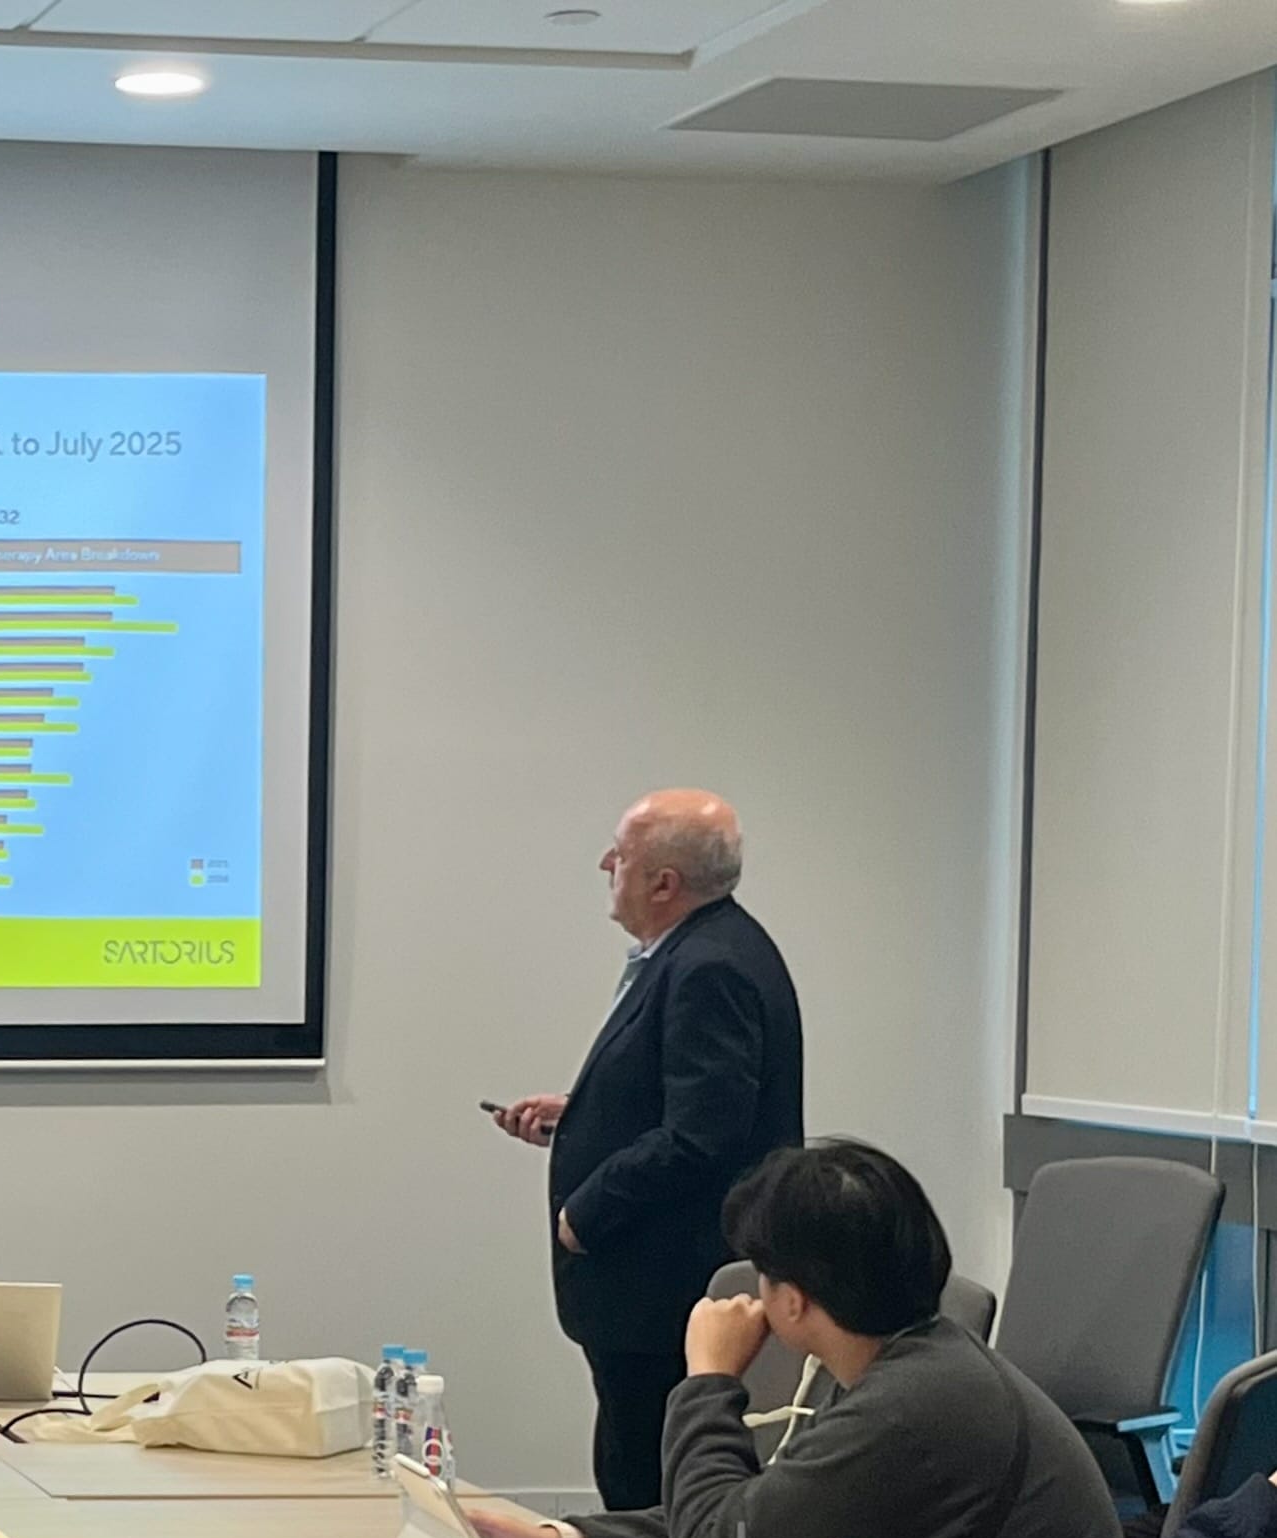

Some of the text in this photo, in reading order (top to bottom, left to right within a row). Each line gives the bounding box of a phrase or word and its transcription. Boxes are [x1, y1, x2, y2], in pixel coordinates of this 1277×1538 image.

[11, 432, 40, 455] to
[46, 431, 103, 463] July
[109, 431, 183, 456] 2025
[45, 548, 77, 561] Area
[81, 548, 160, 562] Breakdown
[103, 940, 236, 965] SARTORIUS
